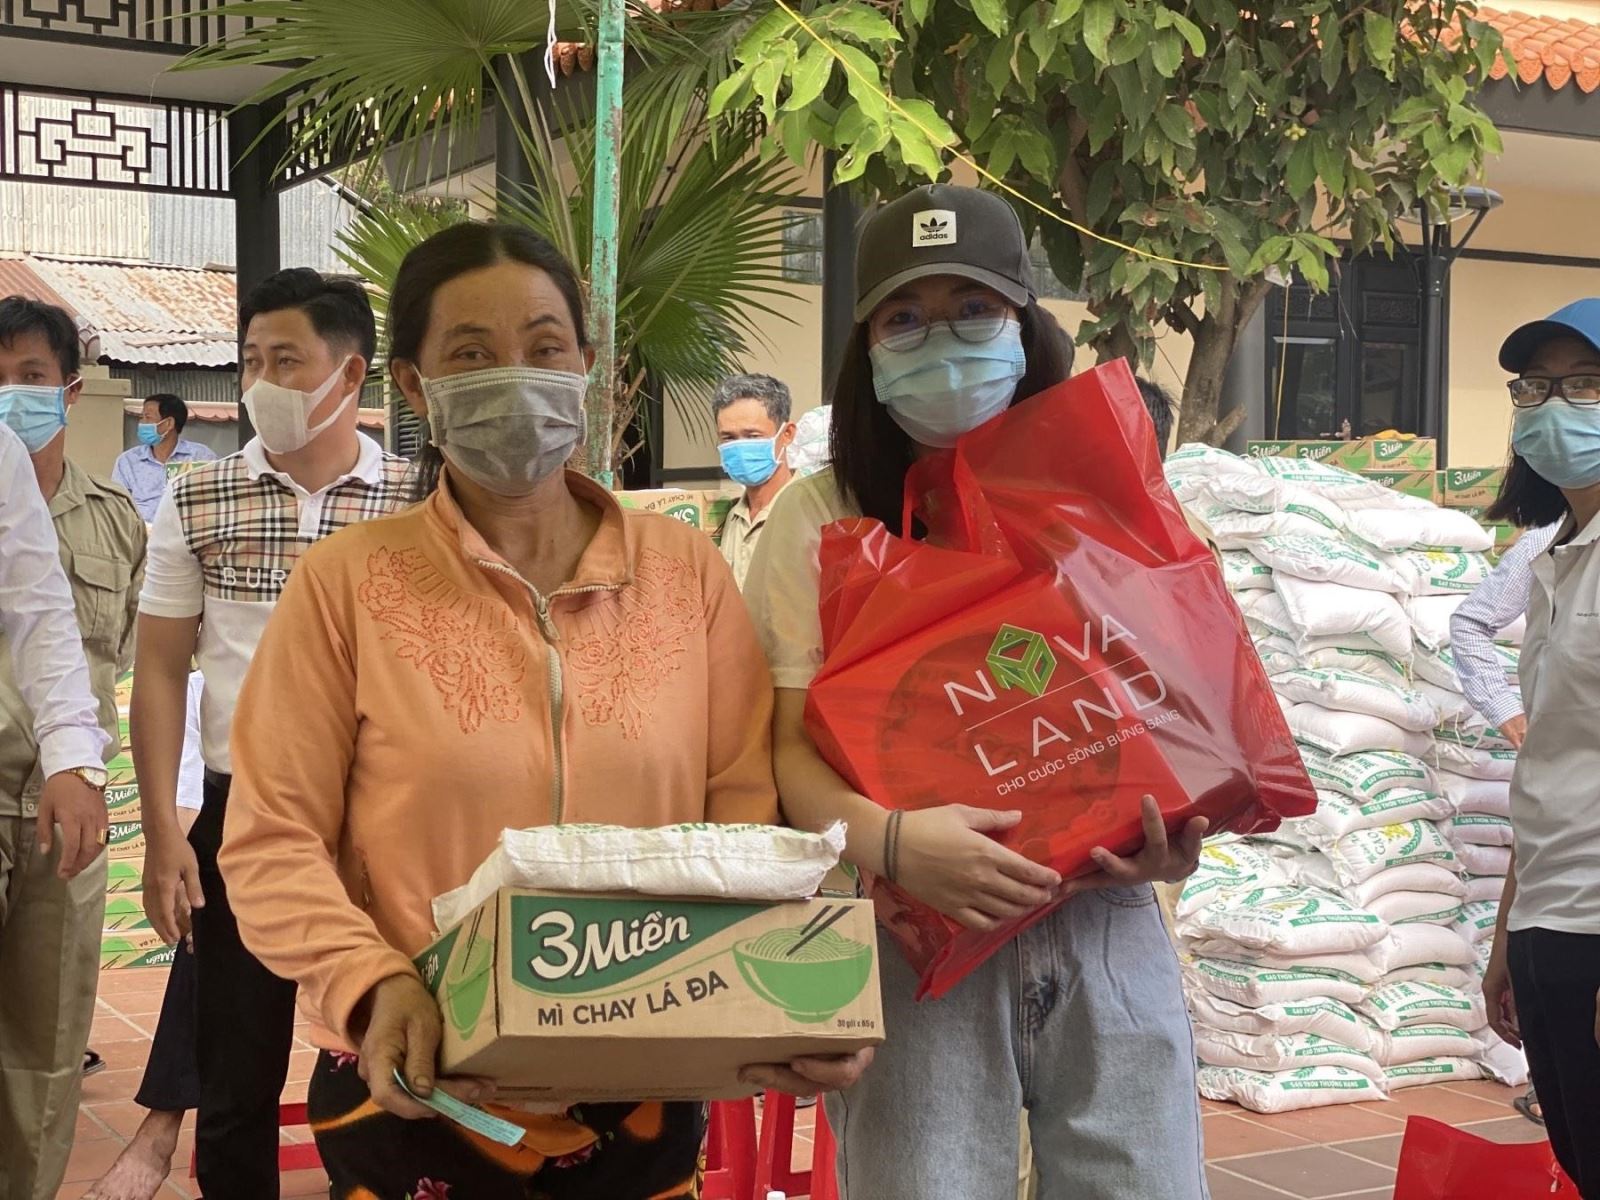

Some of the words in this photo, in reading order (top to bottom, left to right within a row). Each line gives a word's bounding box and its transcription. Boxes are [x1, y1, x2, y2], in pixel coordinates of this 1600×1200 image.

[919, 232, 949, 241] adidas
[973, 669, 1168, 777] LAND
[996, 776, 1026, 796] CHO
[1028, 758, 1066, 782] CUỘC
[537, 1003, 564, 1026] MÌ
[572, 997, 637, 1025] CHAY
[646, 981, 682, 1015] LÁ
[686, 969, 730, 1002] ĐA
